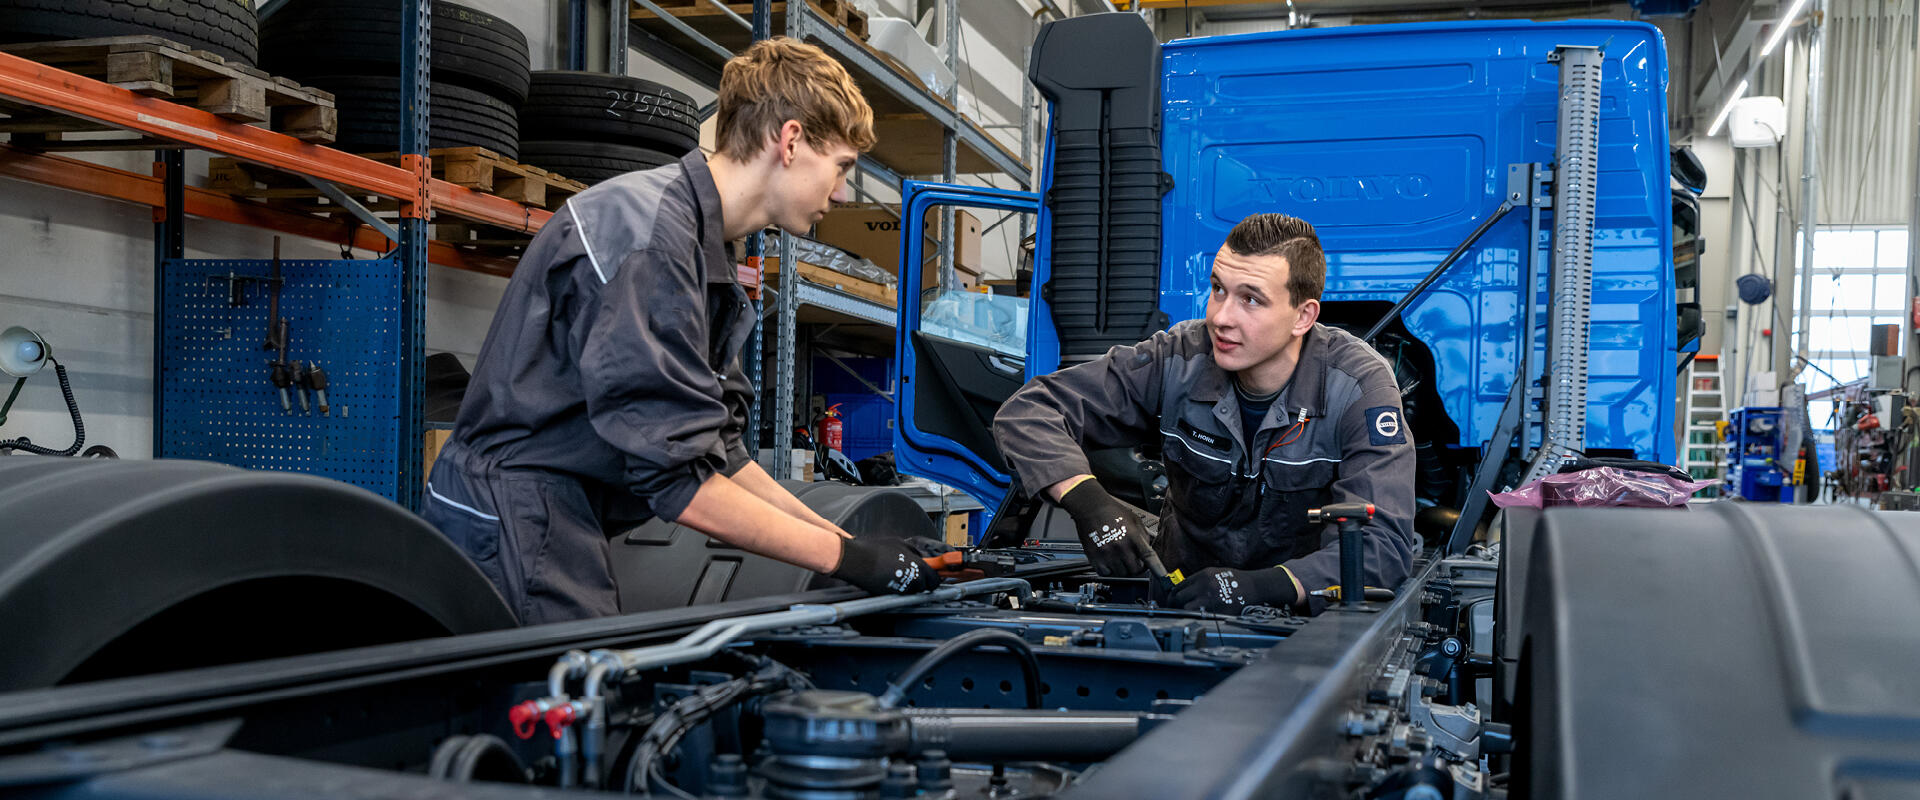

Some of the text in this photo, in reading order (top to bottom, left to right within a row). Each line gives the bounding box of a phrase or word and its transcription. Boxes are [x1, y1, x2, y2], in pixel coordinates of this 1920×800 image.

[1248, 173, 1432, 203] VOLVO
[864, 221, 929, 232] VOL
[1197, 433, 1215, 444] HORN
